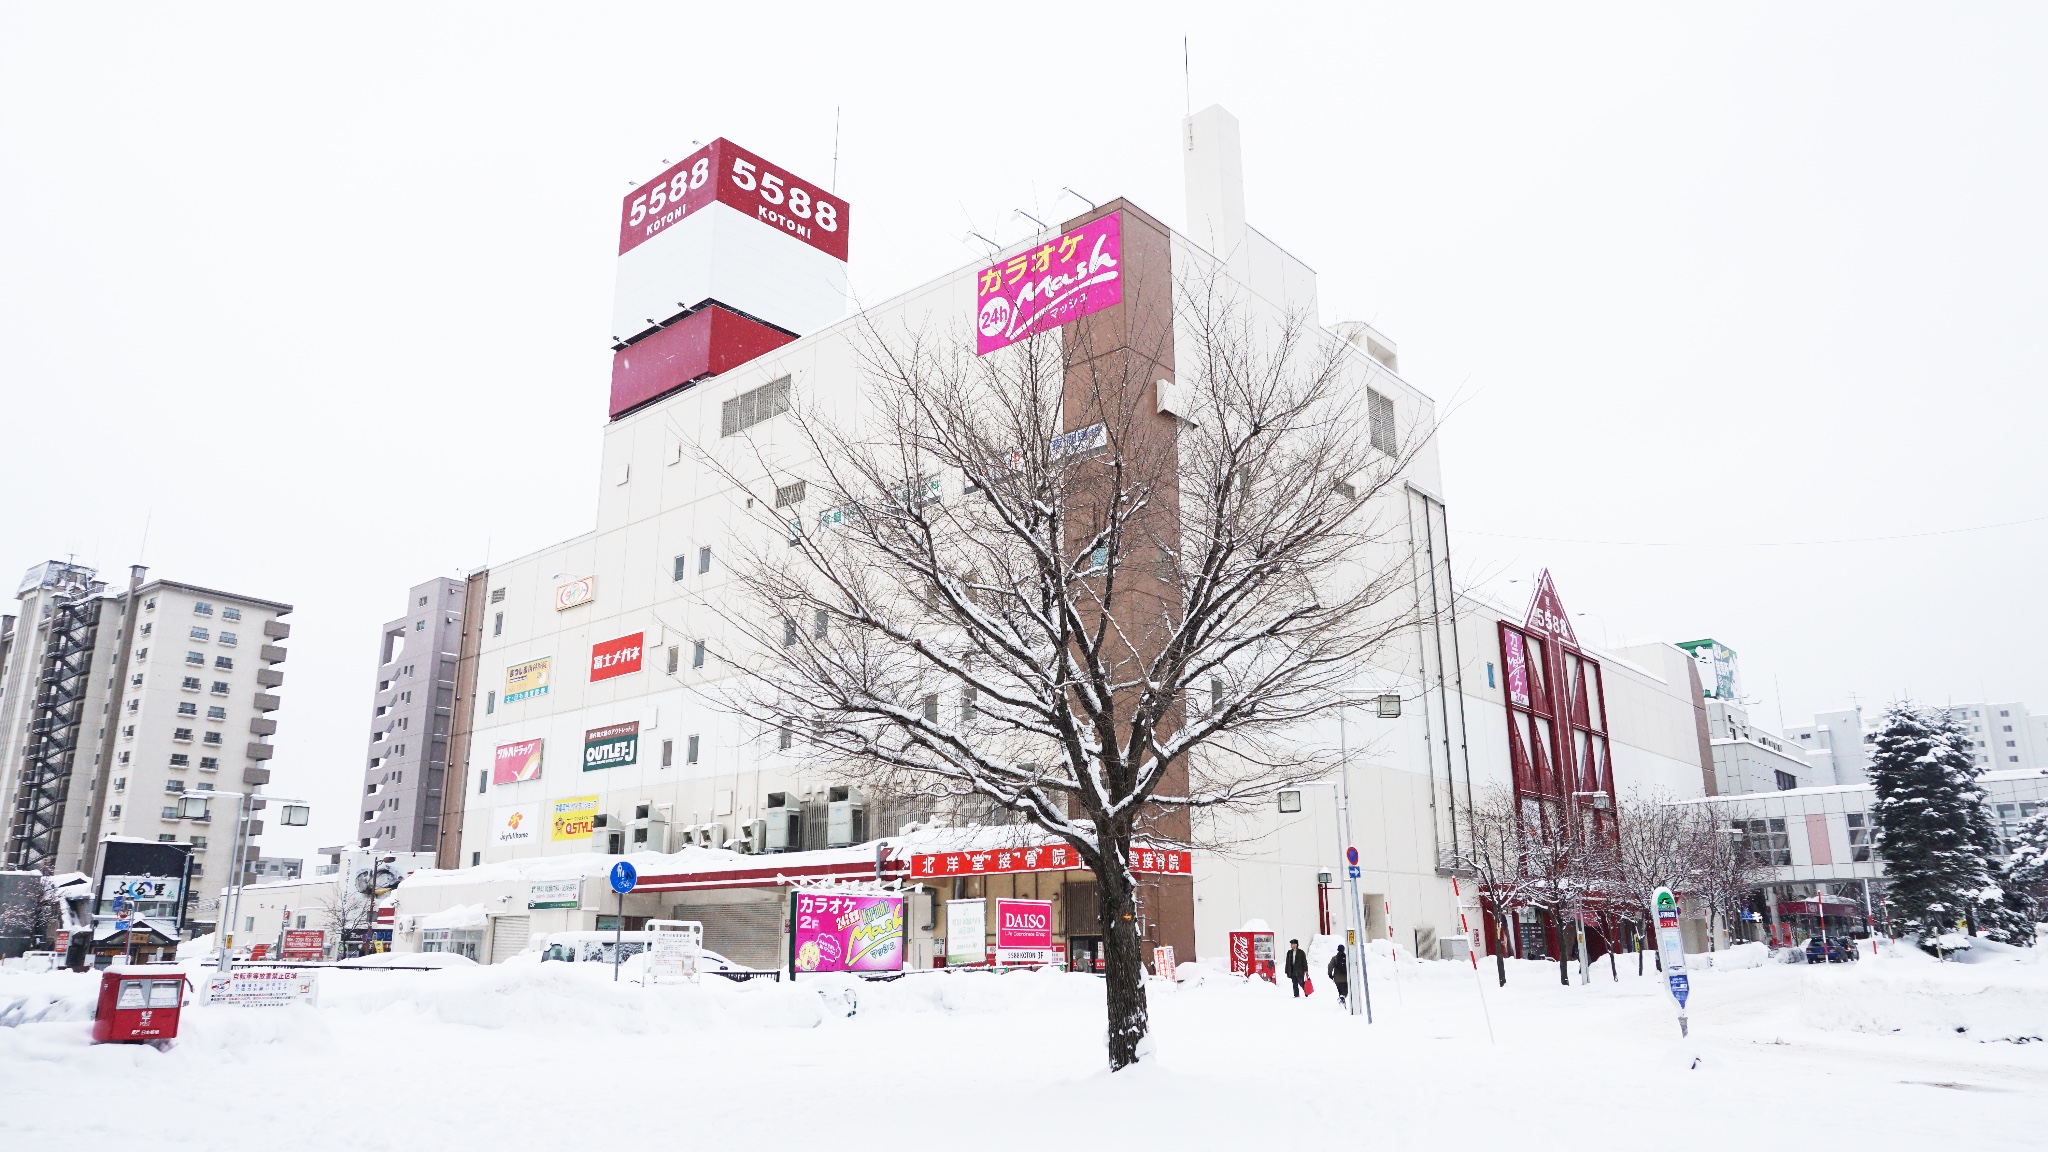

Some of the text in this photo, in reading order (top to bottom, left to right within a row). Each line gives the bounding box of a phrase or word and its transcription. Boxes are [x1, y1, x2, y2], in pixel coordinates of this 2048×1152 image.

[629, 157, 709, 227] 5588
[731, 157, 838, 232] 5588
[646, 203, 686, 236] KOTONI
[758, 204, 811, 239] KOTONI
[979, 234, 1083, 297] カラオケ
[1005, 233, 1118, 338] Mash
[981, 305, 1007, 330] 24h
[1049, 292, 1088, 319] マッシュ
[593, 646, 641, 670] 富士メガネ
[496, 742, 535, 760] ツルハドラッグ
[586, 740, 635, 762] OUTLET-J
[921, 848, 1067, 875] 北洋堂接骨院
[1128, 849, 1180, 871] 堂接骨院
[113, 881, 166, 896] ふる里
[799, 896, 857, 914] カラオケ
[799, 915, 819, 930] 2F
[845, 902, 903, 965] Mash
[1005, 912, 1046, 929] DAISO
